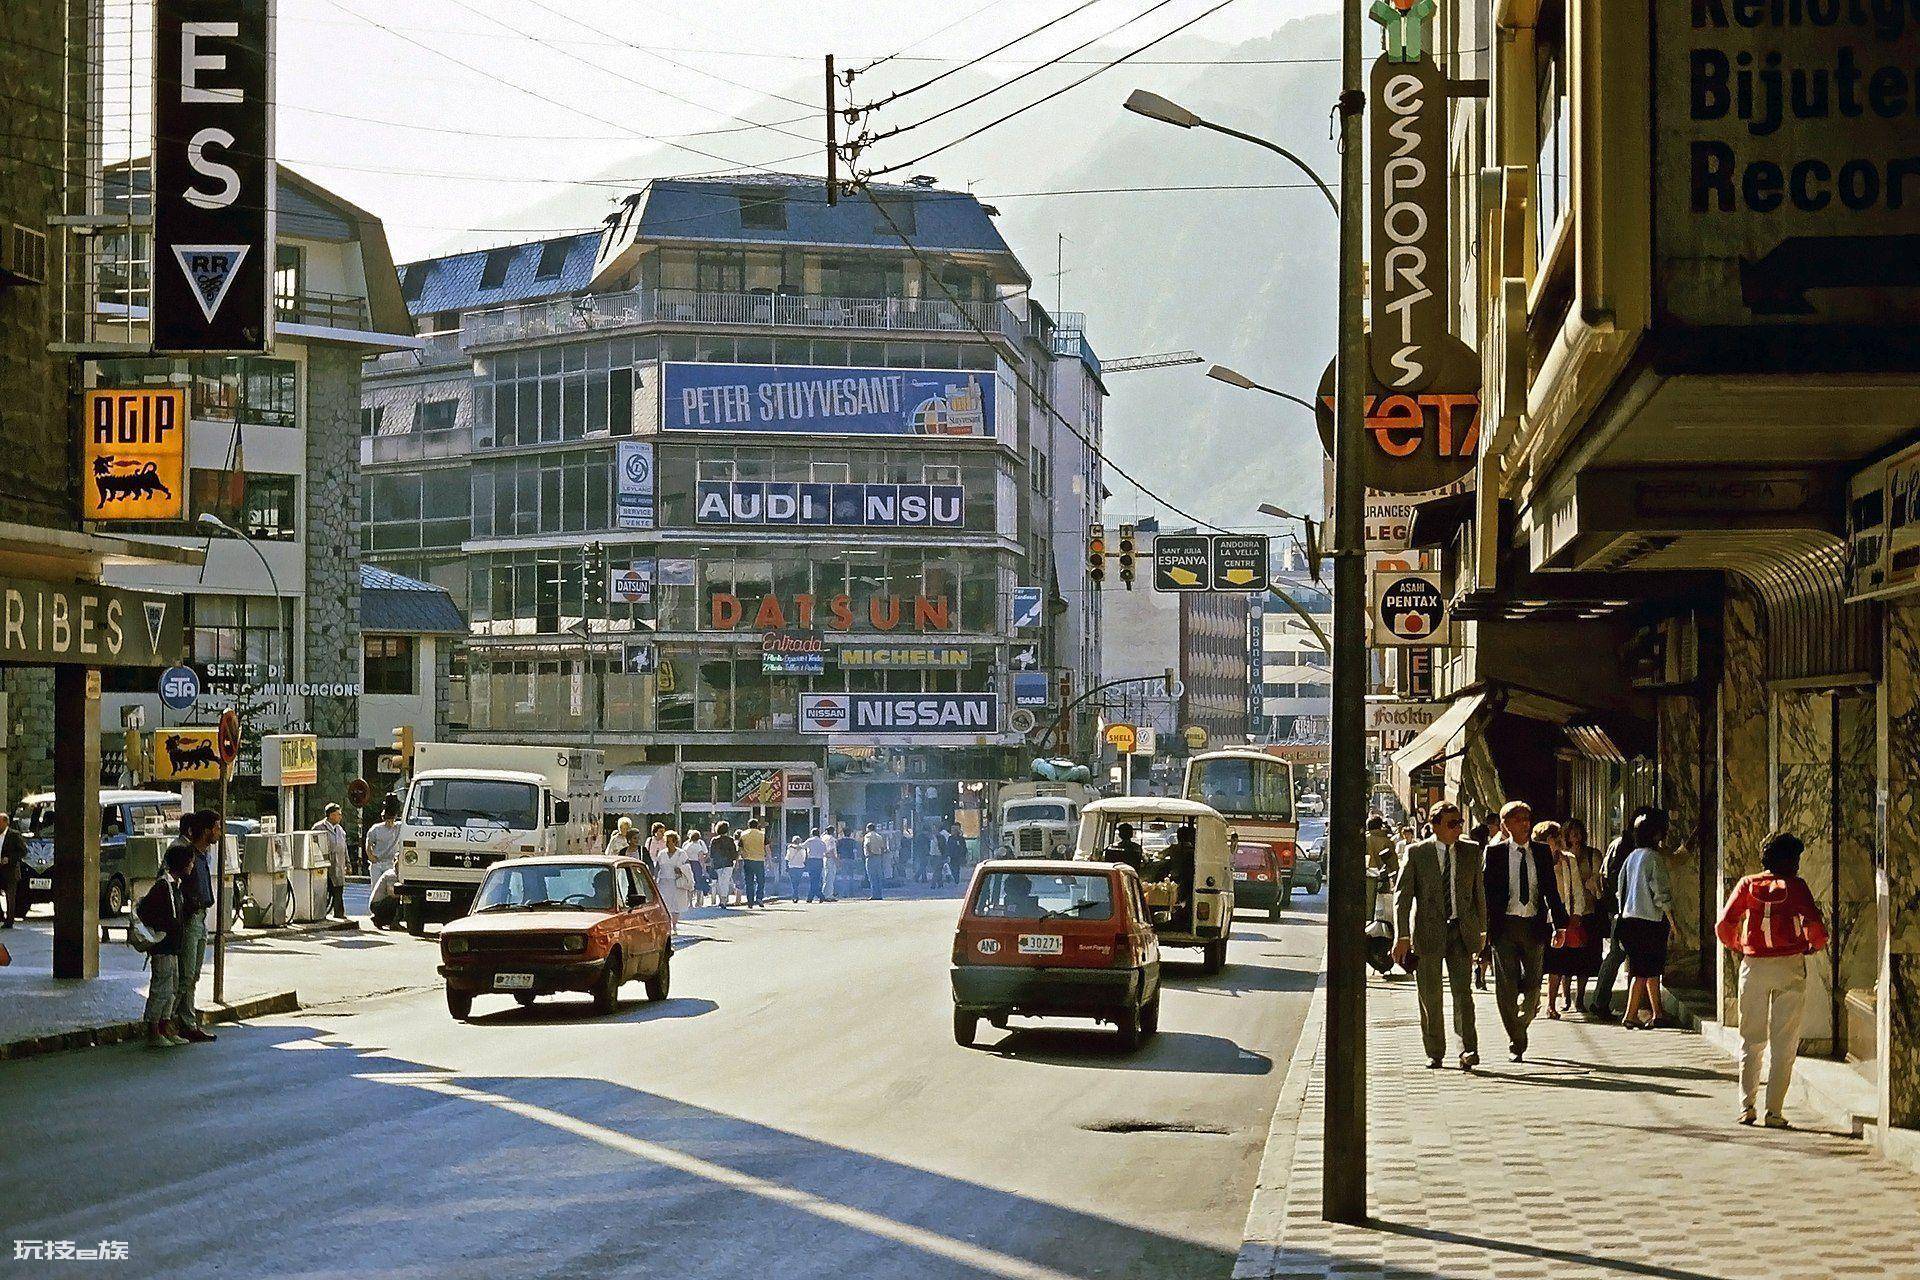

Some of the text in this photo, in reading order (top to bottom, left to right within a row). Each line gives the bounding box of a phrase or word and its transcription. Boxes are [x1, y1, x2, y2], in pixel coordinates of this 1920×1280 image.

[1690, 47, 1920, 135] Bijute
[192, 256, 228, 272] RR
[683, 376, 901, 425] PETER STUYVESANT
[94, 396, 174, 444] AGIP
[699, 493, 961, 522] AUDI NSU
[1158, 557, 1207, 565] ESPANYA
[617, 580, 648, 592] DATSUN
[1400, 583, 1424, 592] ASAHI
[1387, 596, 1437, 608] PENTAX
[711, 594, 950, 630] DATSUN
[4, 588, 124, 655] RIBES
[762, 632, 822, 652] Entrada
[841, 649, 967, 665] MICHELIN
[1251, 625, 1262, 725] Banca Mora
[165, 677, 195, 698] STA
[807, 708, 844, 717] NISSAN
[857, 700, 987, 727] NISSAN
[415, 829, 462, 840] congelats
[981, 941, 999, 951] AND
[1030, 938, 1060, 949] 30271
